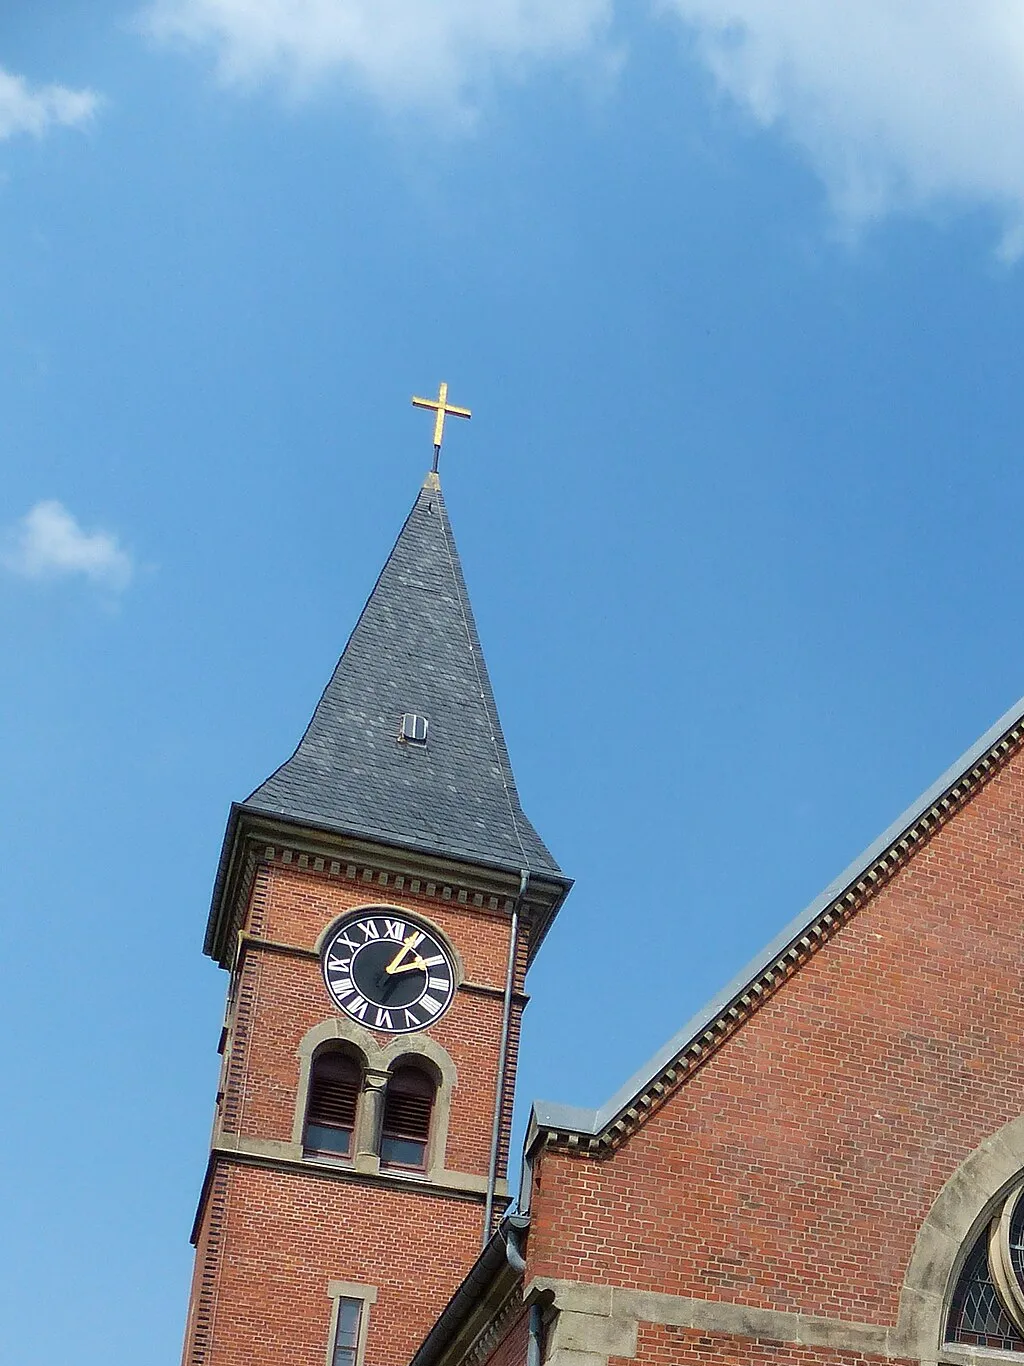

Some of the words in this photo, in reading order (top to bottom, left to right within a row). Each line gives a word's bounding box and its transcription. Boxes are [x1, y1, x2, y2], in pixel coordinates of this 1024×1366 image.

[357, 920, 379, 941] XI
[384, 920, 406, 940] XII
[336, 932, 360, 953] X
[328, 954, 350, 972] IX
[423, 954, 445, 967] II
[331, 978, 355, 1000] VIII
[429, 977, 449, 991] III
[347, 995, 369, 1020] VII
[375, 1008, 393, 1028] VI
[405, 1009, 421, 1027] V
